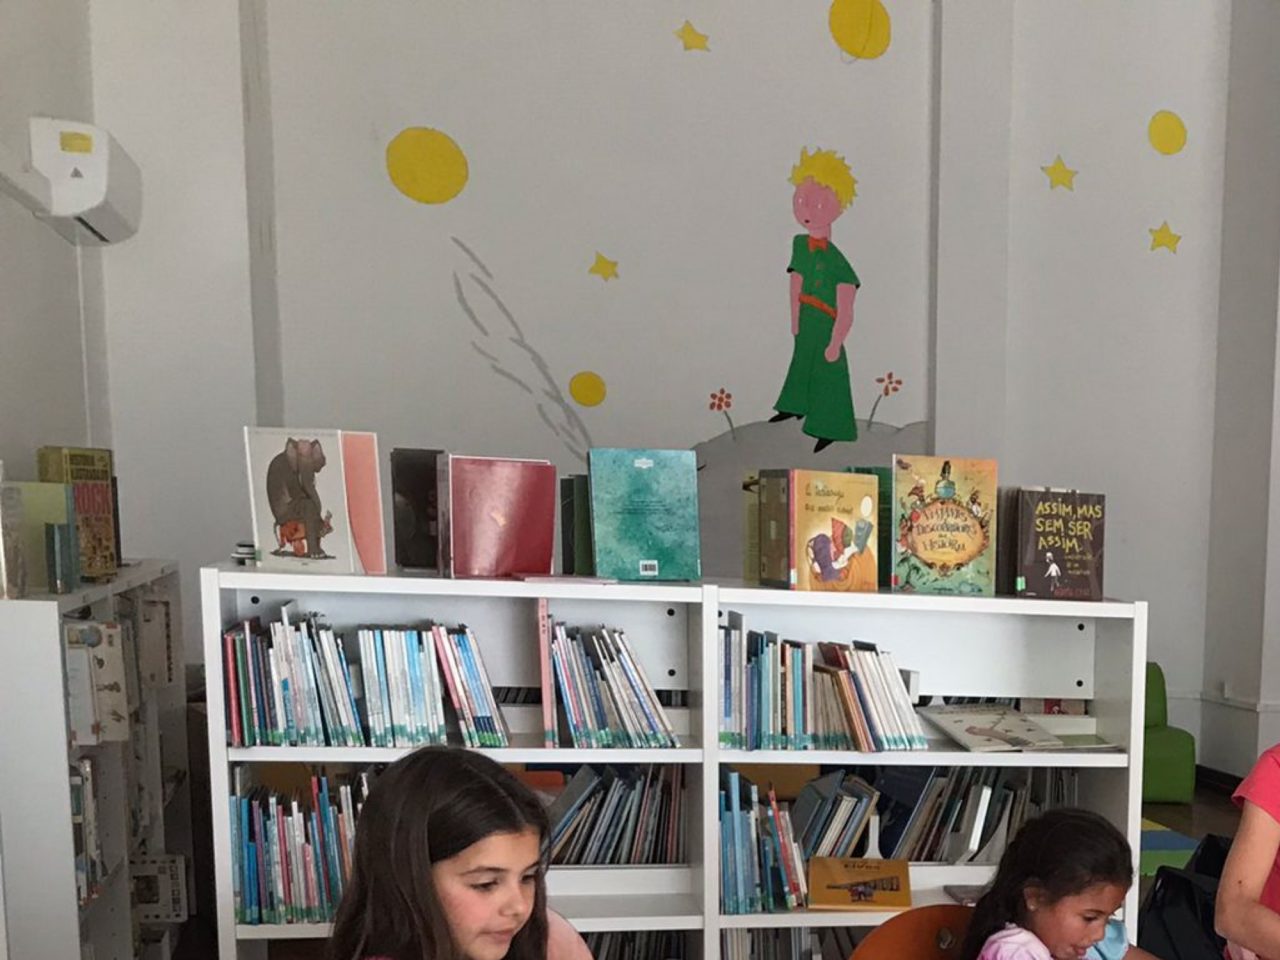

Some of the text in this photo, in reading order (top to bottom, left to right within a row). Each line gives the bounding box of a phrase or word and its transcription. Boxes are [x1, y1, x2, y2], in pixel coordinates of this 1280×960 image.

[1077, 504, 1102, 518] MAS
[1035, 517, 1093, 540] SEM SER
